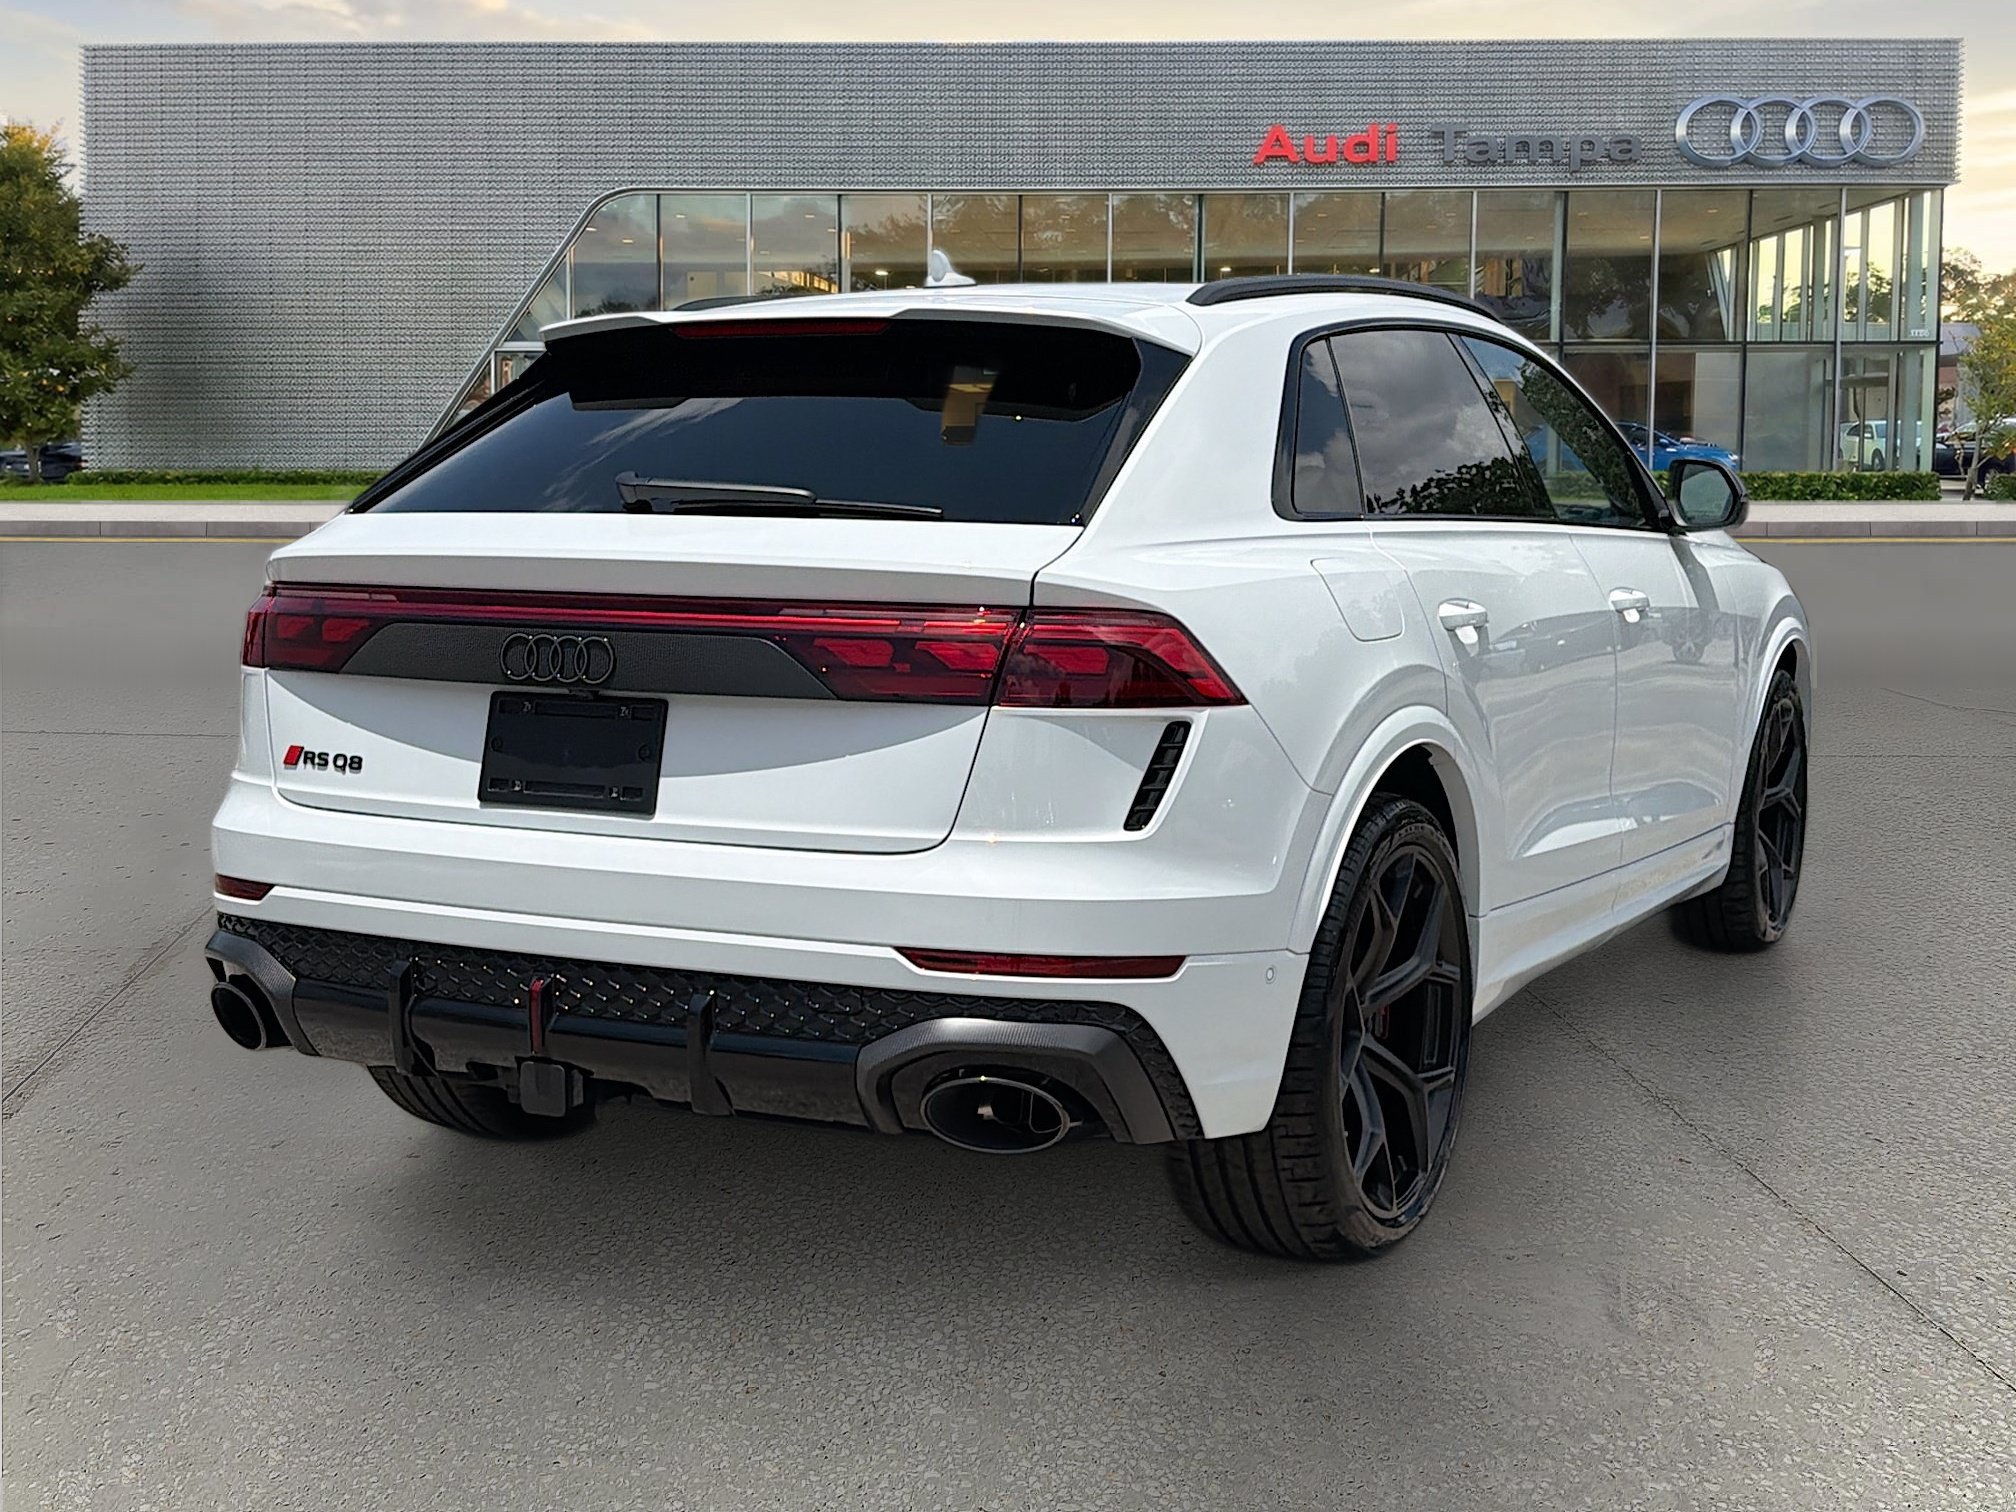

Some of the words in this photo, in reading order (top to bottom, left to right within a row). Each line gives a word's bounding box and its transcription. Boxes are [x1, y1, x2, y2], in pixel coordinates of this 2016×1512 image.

[1253, 123, 1398, 165] Audi
[1430, 123, 1643, 173] Tampa
[303, 751, 329, 767] RS
[333, 754, 363, 774] Q8
